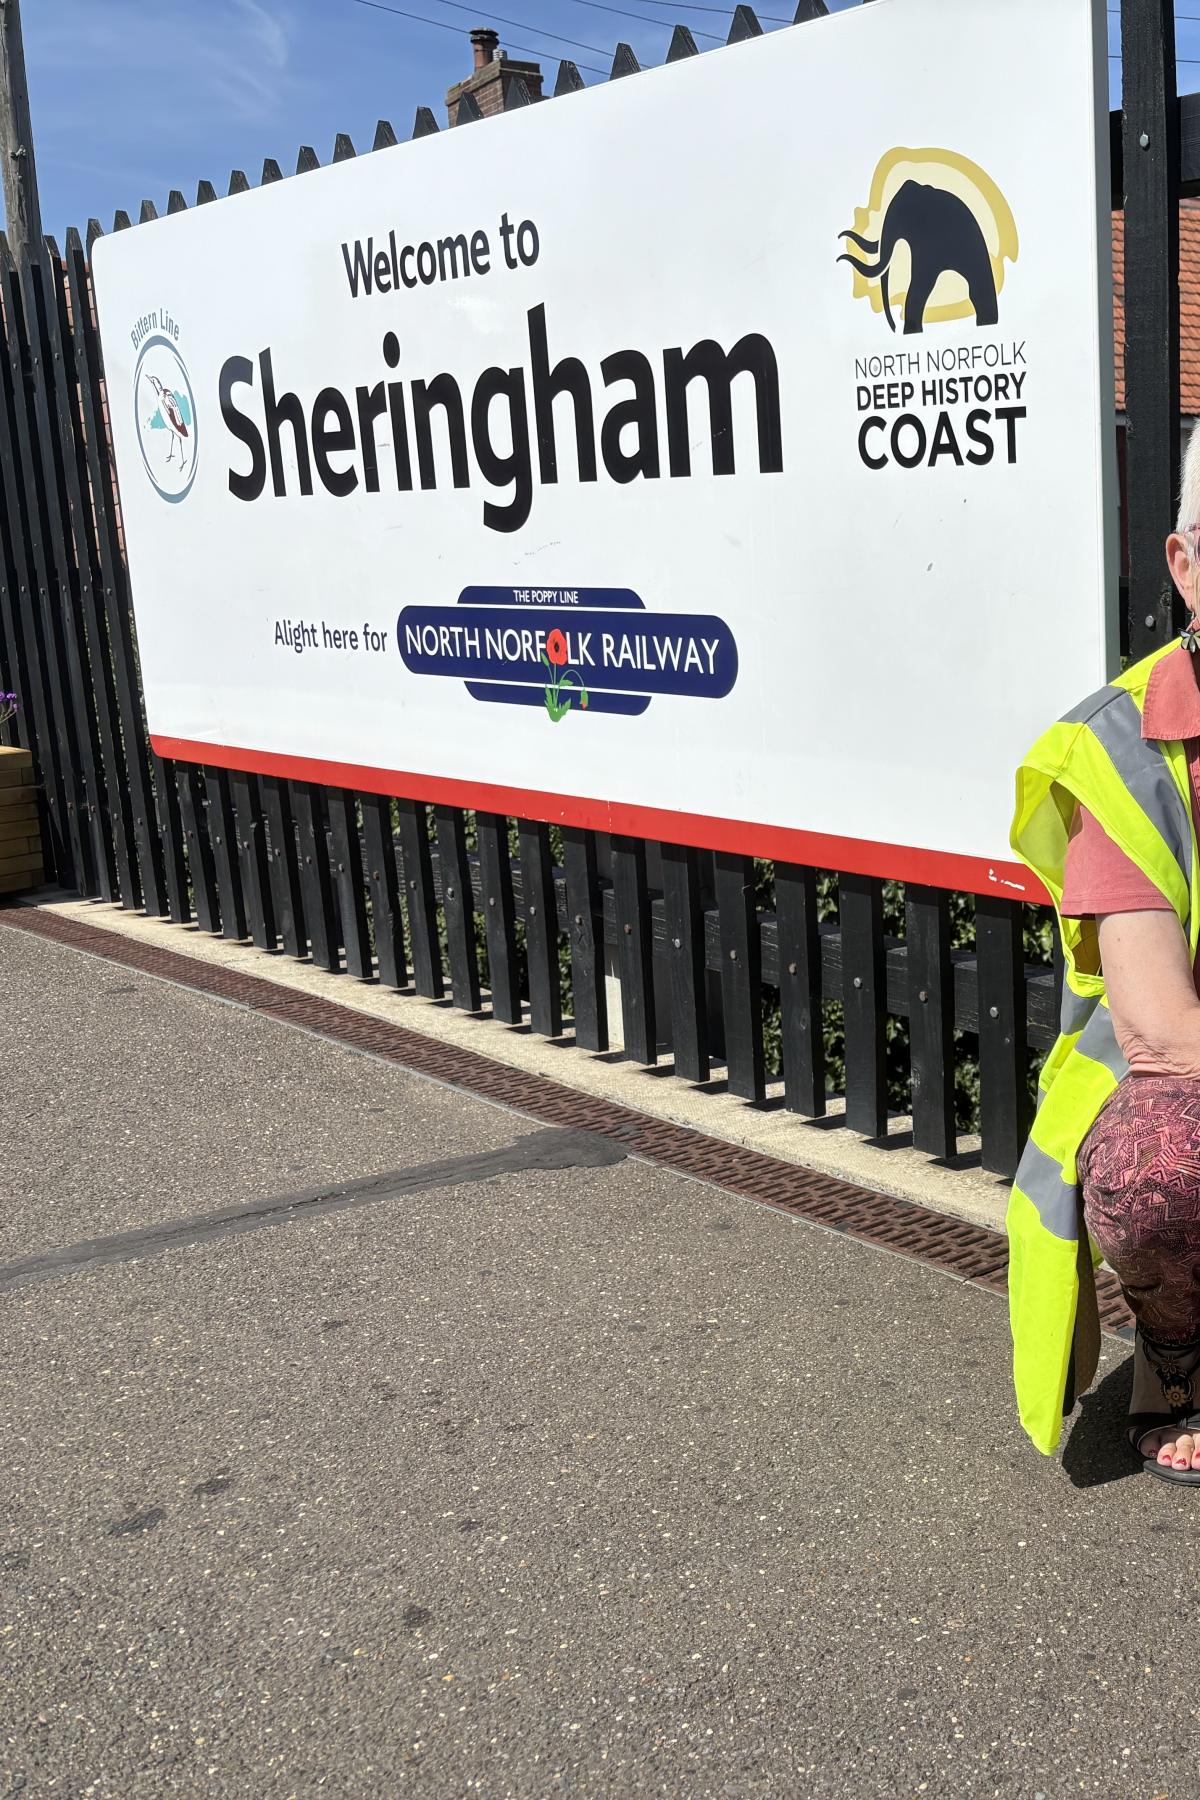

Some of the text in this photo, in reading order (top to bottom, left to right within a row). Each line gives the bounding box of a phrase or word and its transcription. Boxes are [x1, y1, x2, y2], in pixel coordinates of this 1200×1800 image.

[342, 212, 540, 298] Welcome to
[131, 308, 179, 350] Bittern Line
[855, 341, 1027, 379] NORTH NORFOLK
[856, 371, 1027, 411] DEEP HISTORY
[218, 302, 784, 534] Sheringham
[857, 406, 1027, 471] COAST
[512, 589, 579, 604] THE POPPY LINE
[274, 620, 388, 654] Alight here for
[405, 625, 481, 659] NORTH
[602, 634, 720, 675] RAILWAY
